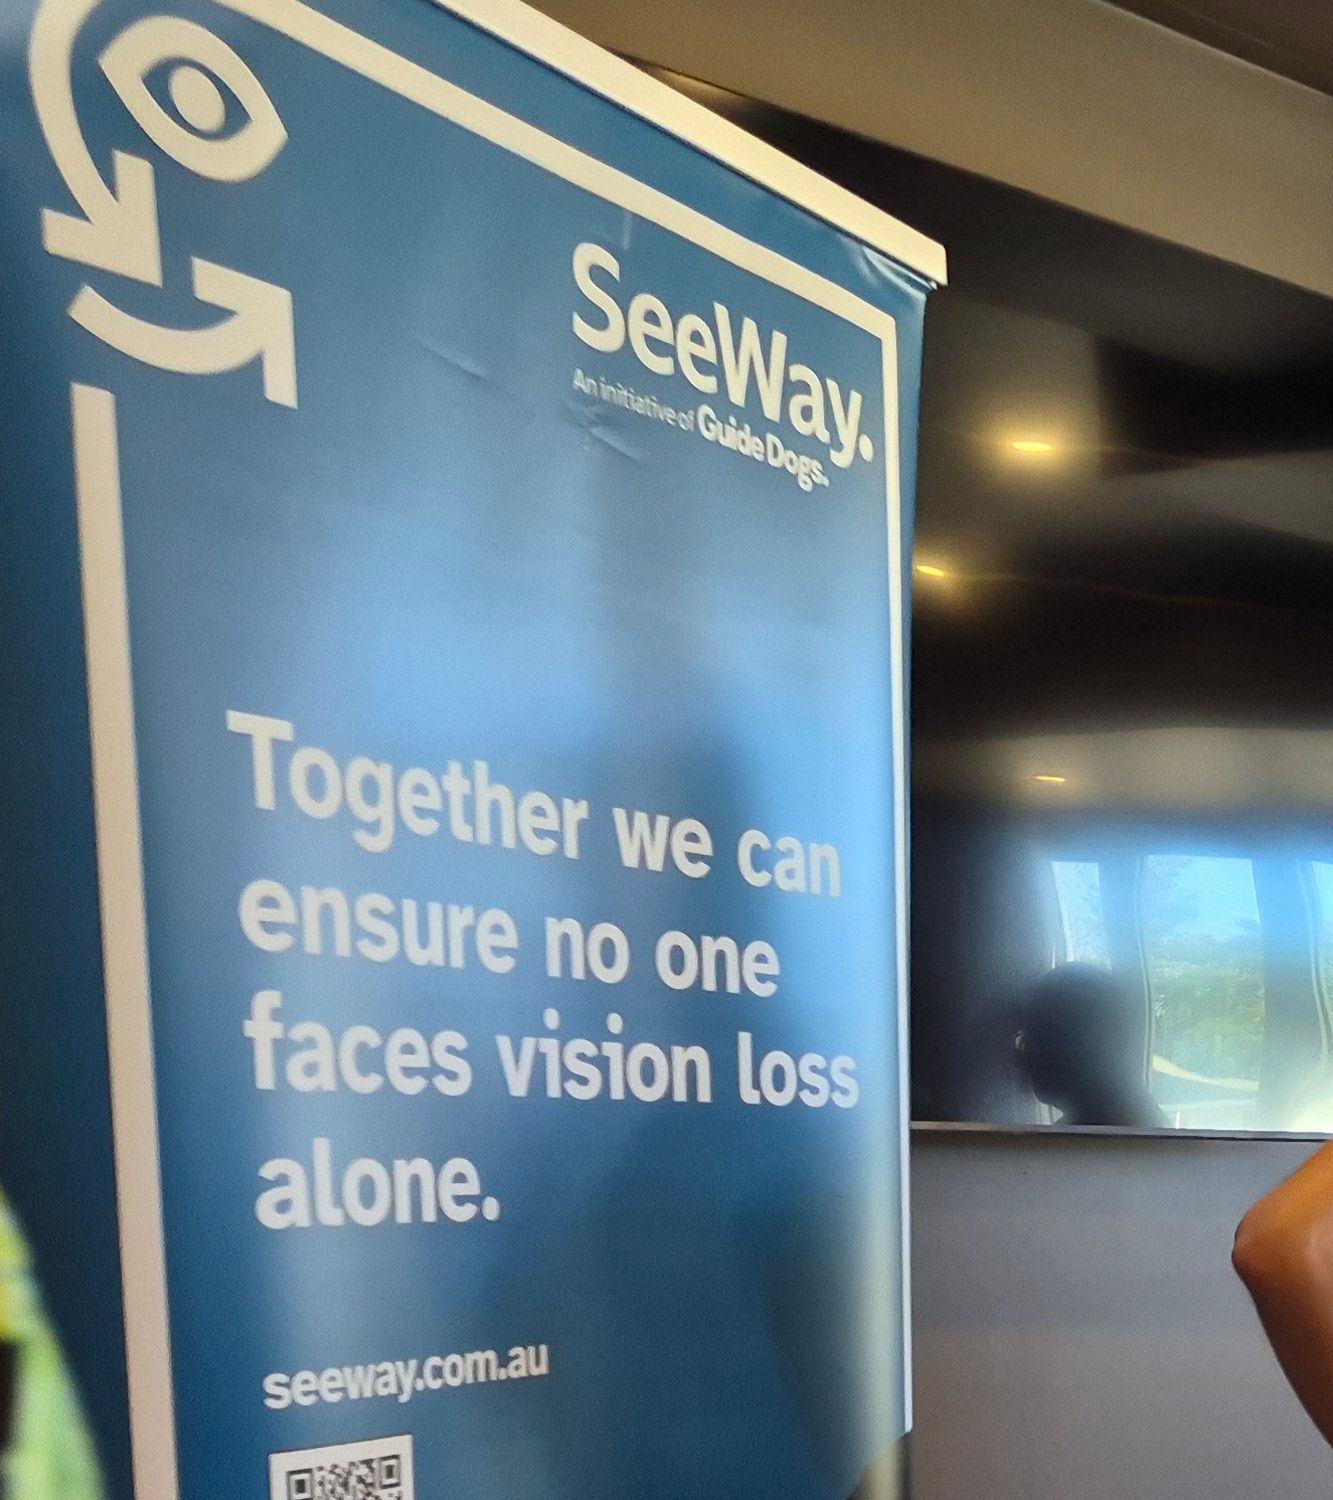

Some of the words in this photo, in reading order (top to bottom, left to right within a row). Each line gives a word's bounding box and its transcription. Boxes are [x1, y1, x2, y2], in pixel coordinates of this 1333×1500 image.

[573, 242, 873, 469] SeeWay.
[599, 377, 677, 425] initiative
[697, 404, 765, 461] Guide
[766, 433, 830, 492] Dogs.
[225, 709, 589, 853] Together
[613, 806, 714, 878] we
[737, 829, 842, 897] can
[239, 878, 519, 974] ensure
[545, 914, 630, 985] no
[655, 929, 781, 998] one
[242, 991, 473, 1096] faces
[496, 1008, 712, 1105] vision
[737, 1031, 860, 1108] loss
[255, 1137, 500, 1229] alone.
[262, 1342, 550, 1410] seeway.com.au
